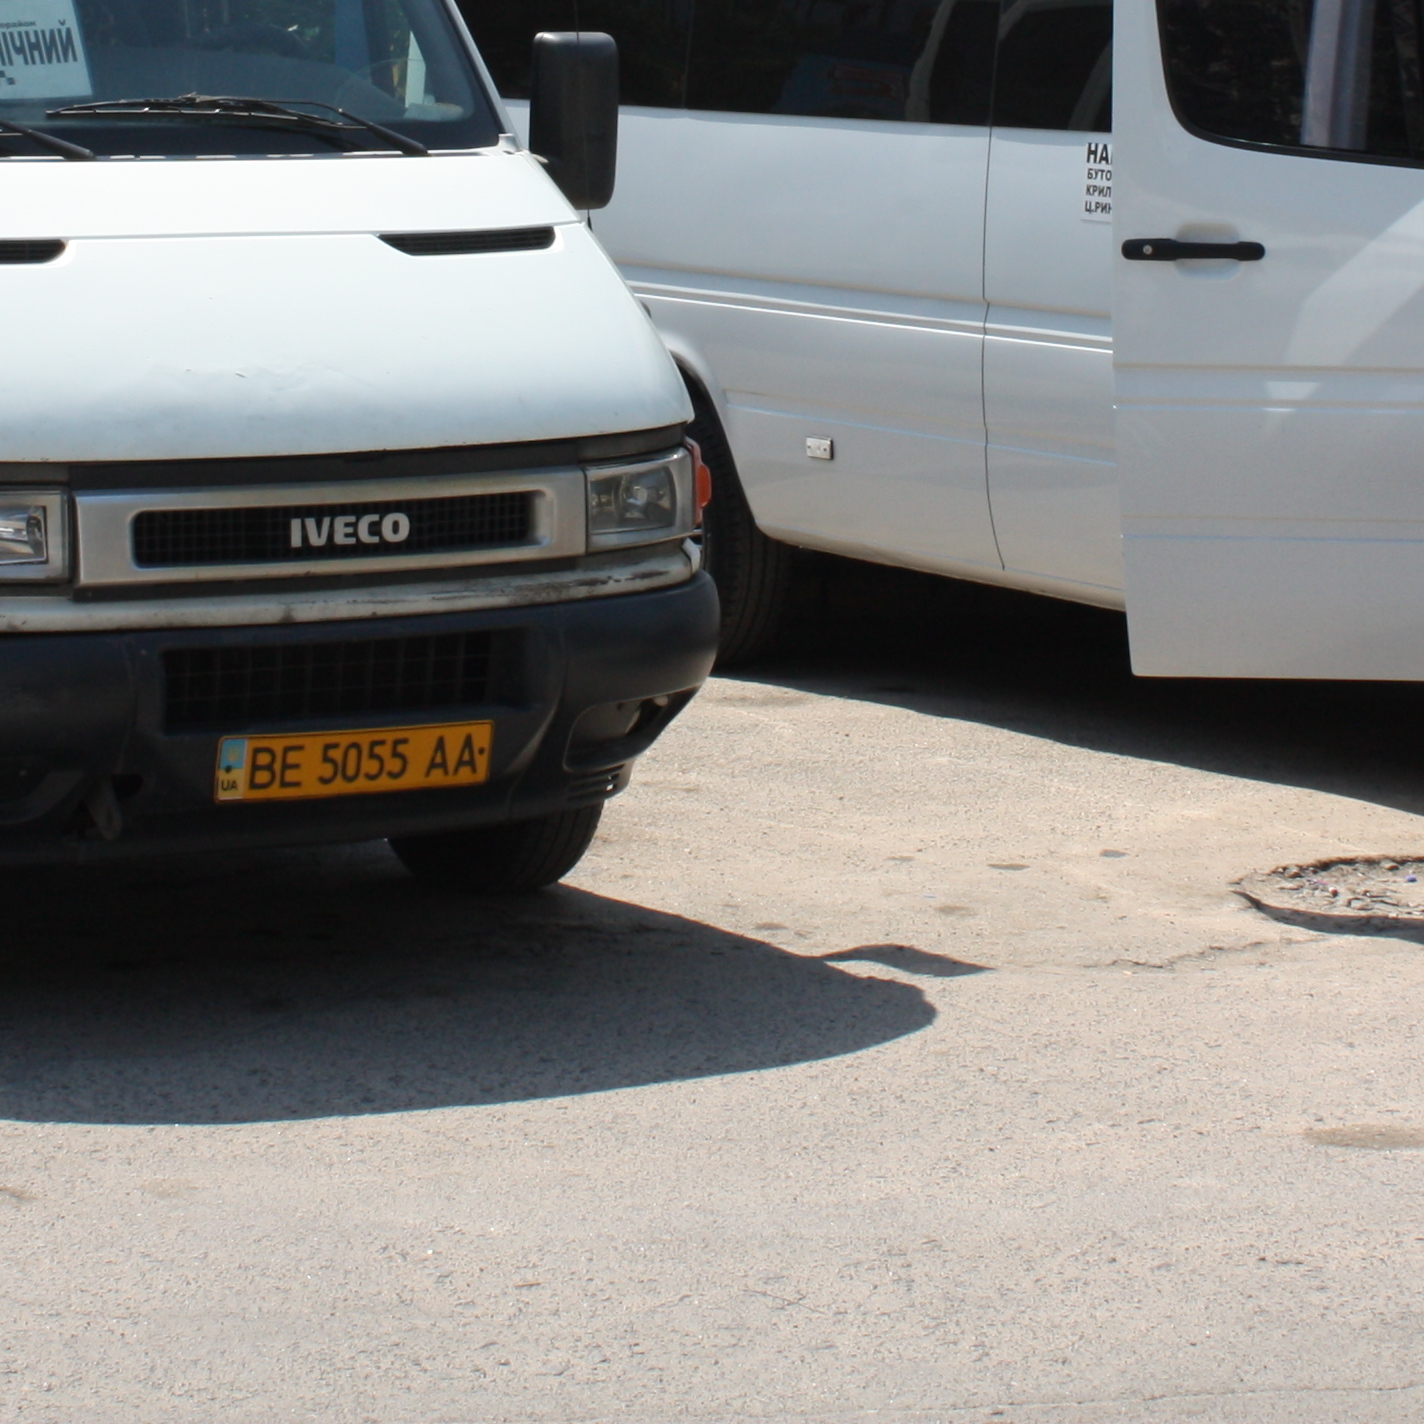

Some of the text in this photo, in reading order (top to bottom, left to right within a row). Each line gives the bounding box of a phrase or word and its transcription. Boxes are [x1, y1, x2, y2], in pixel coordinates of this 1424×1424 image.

[1086, 142, 1113, 165] НА
[289, 512, 411, 549] IVECO
[248, 733, 478, 791] BE 5055 AA
[221, 779, 238, 792] UA
